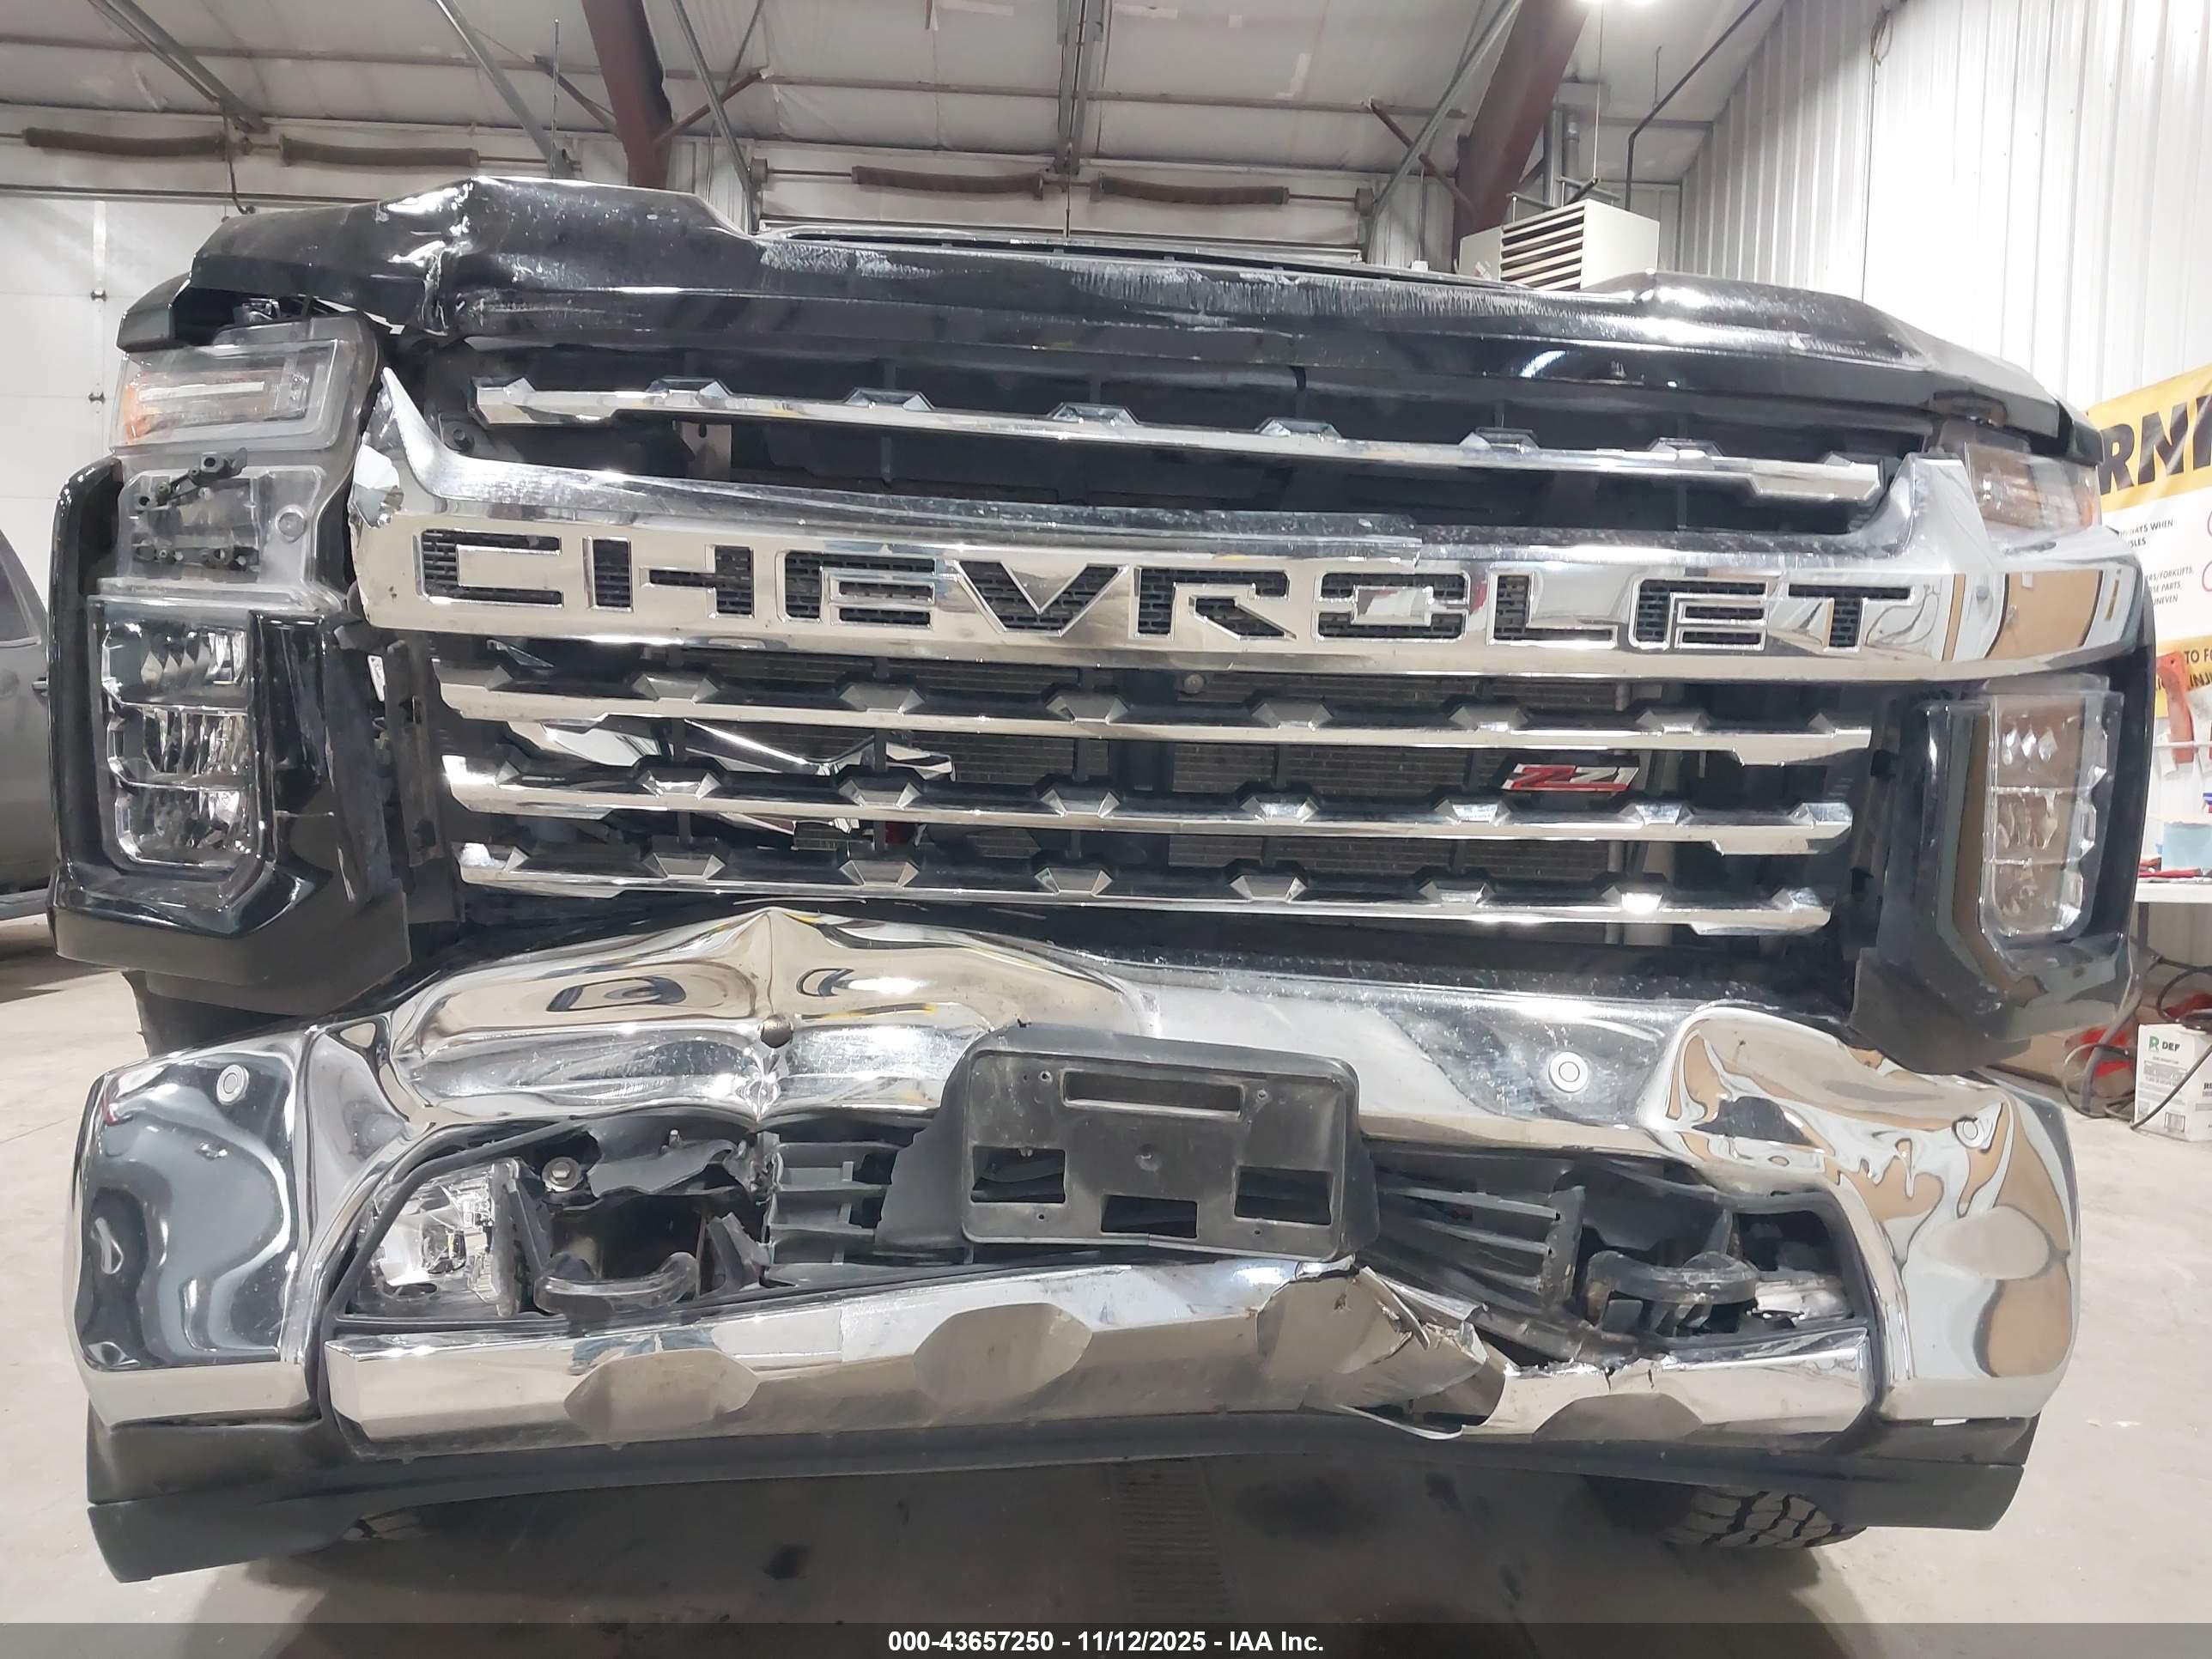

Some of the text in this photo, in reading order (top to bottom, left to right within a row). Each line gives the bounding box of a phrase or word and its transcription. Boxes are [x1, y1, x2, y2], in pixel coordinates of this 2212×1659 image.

[2149, 518, 2173, 531] WHEN
[413, 527, 1916, 653] CHEVROLET
[2184, 649, 2200, 665] TO
[1500, 763, 1638, 792] Z71
[2161, 1041, 2180, 1052] DEF
